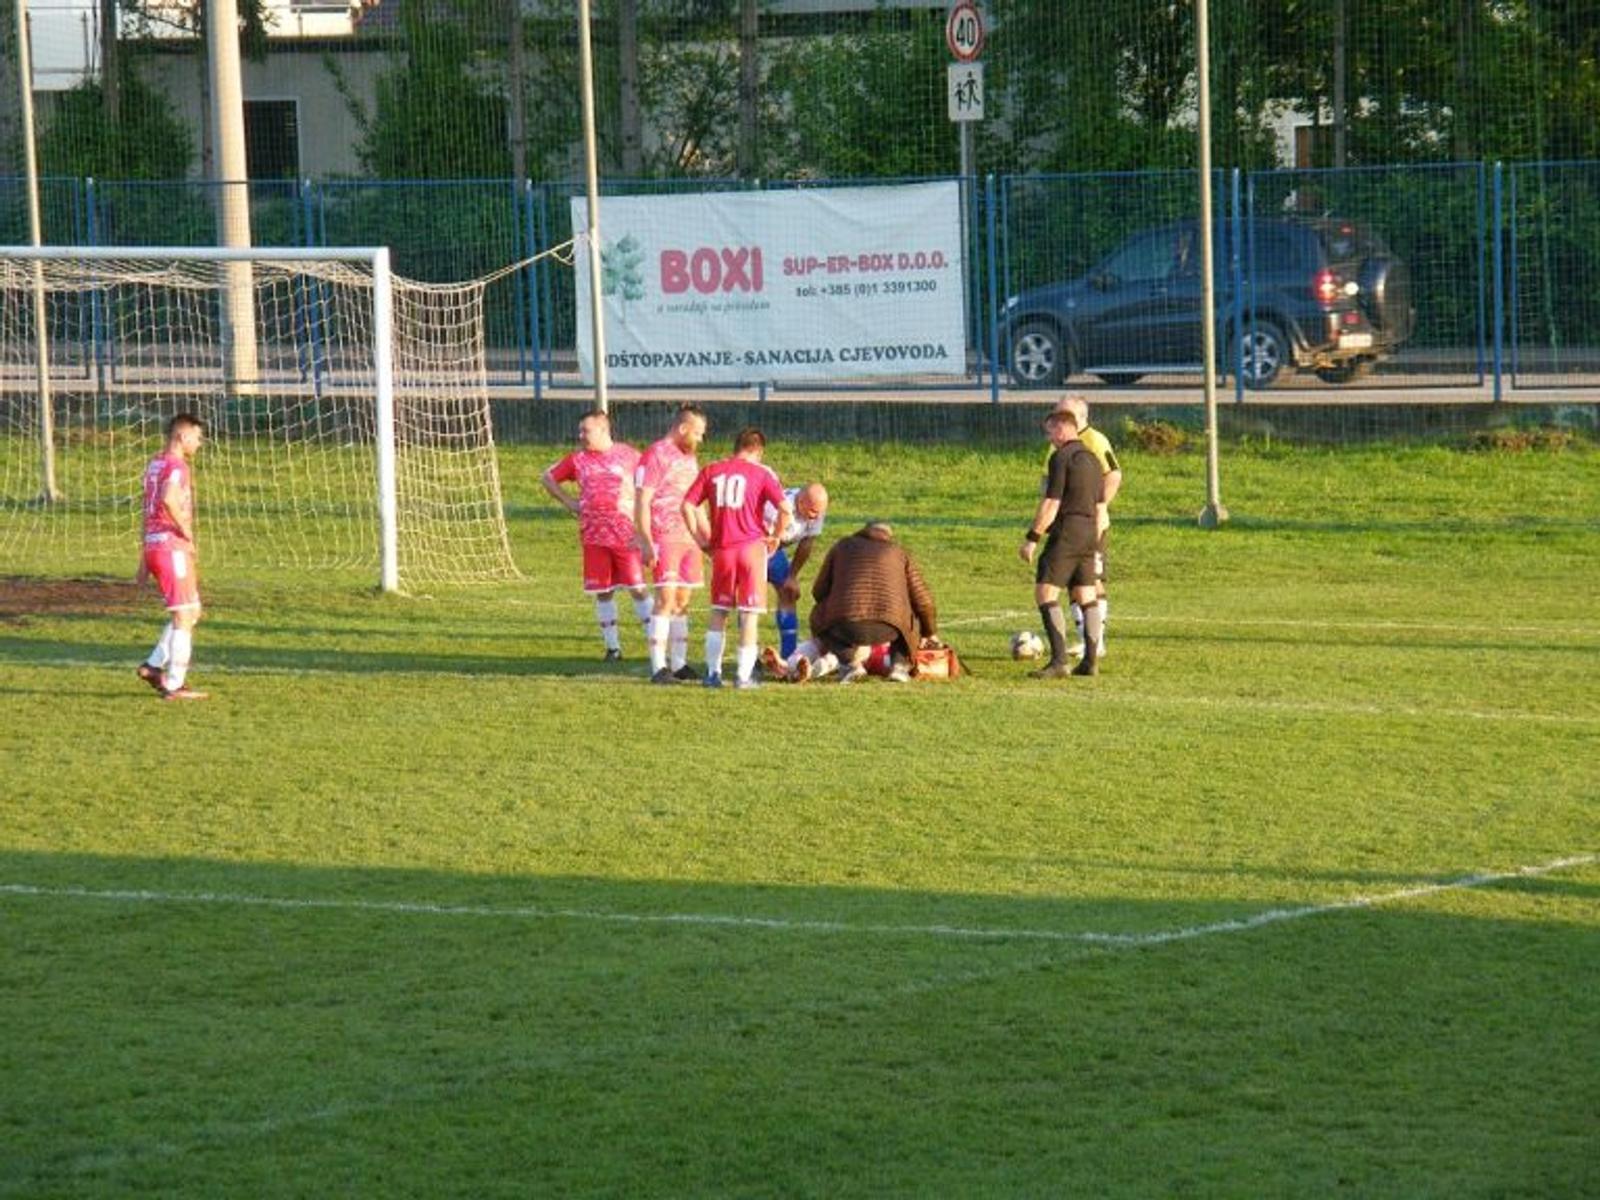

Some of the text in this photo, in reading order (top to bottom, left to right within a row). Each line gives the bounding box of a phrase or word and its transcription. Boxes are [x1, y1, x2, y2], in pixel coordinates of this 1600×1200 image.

[956, 17, 975, 47] 40
[661, 247, 763, 294] BOXI
[783, 251, 949, 276] SUP-ER-BOX D.O.O.
[822, 283, 851, 296] +385
[854, 282, 878, 297] (0)1
[883, 279, 937, 295] 3391300
[605, 350, 733, 368] DŠTOPAVANJE
[744, 349, 834, 366] SANACIJA
[839, 344, 948, 362] CJEVOVODA
[711, 474, 746, 509] 10
